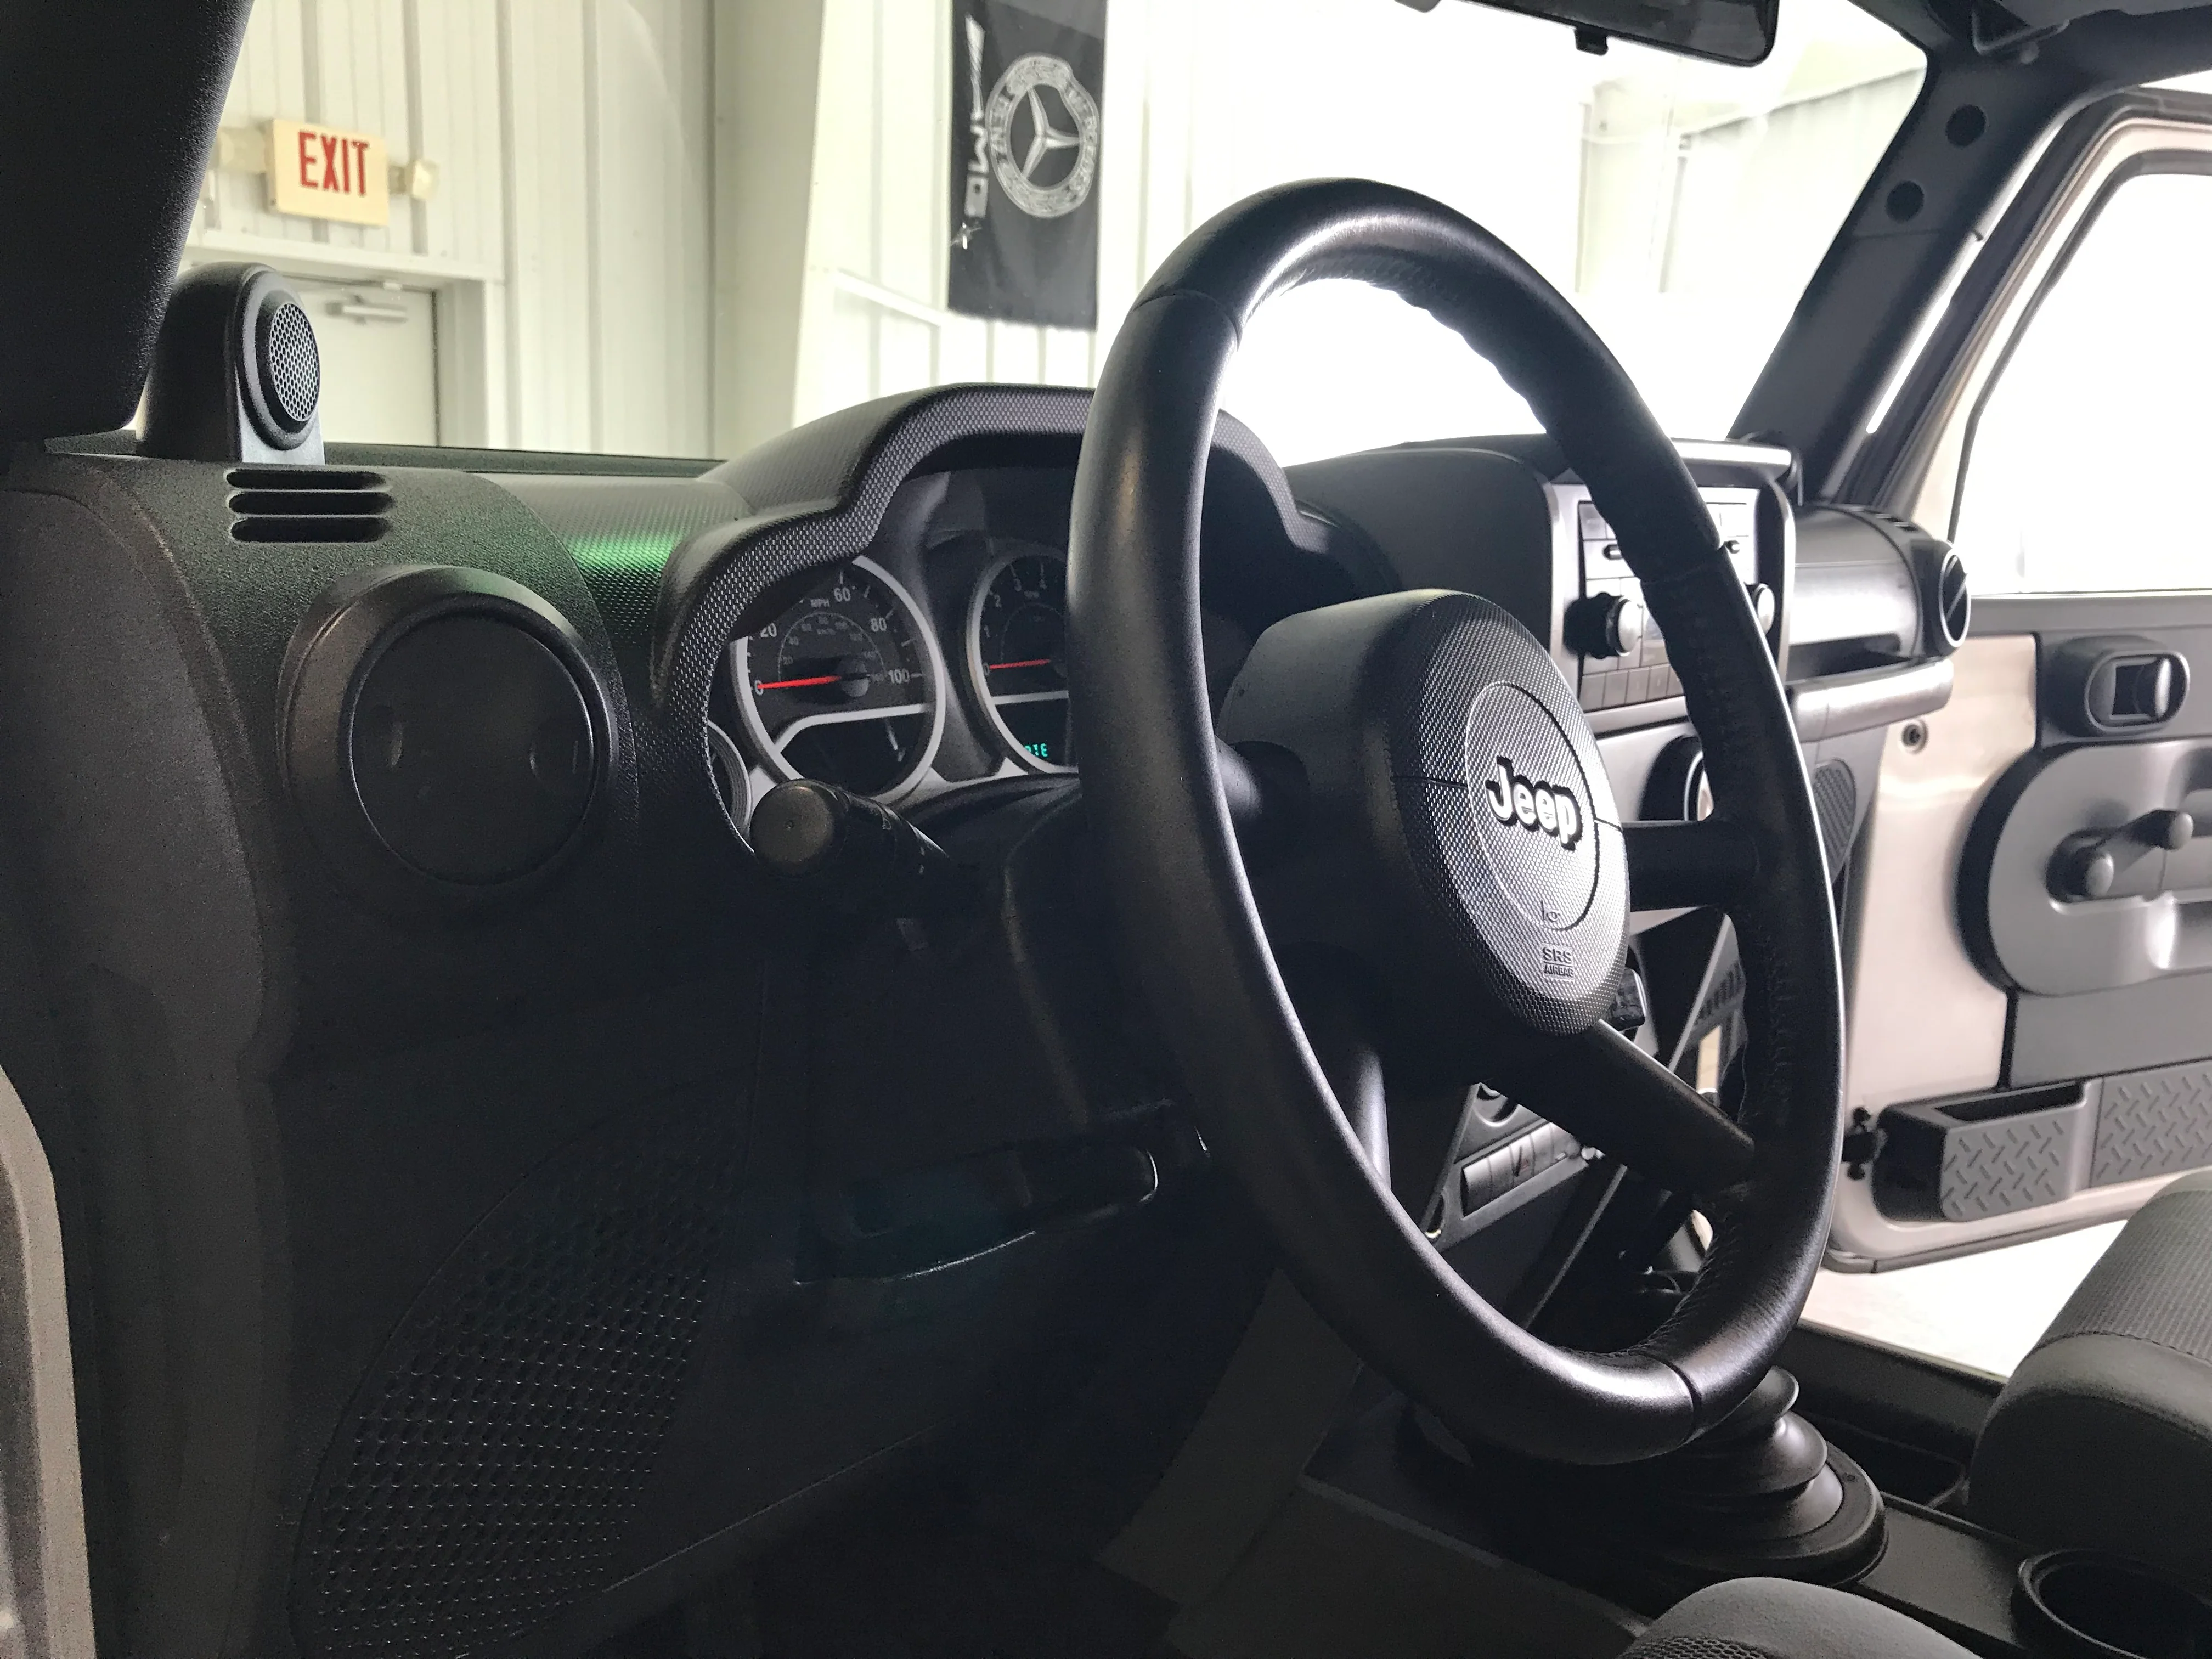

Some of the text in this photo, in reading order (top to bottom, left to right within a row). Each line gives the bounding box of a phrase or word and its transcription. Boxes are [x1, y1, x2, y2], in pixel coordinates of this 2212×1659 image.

[298, 130, 369, 197] EXIT
[1013, 578, 1022, 591] 3
[833, 587, 851, 602] 60
[994, 594, 1002, 608] 2
[810, 598, 830, 607] MPH
[760, 622, 777, 638] 20
[870, 618, 887, 632] 80
[888, 669, 910, 684] 100
[754, 680, 764, 696] 0
[1485, 755, 1583, 850] Jeep
[1542, 946, 1572, 964] SRS
[1544, 964, 1574, 978] AIRBAG
